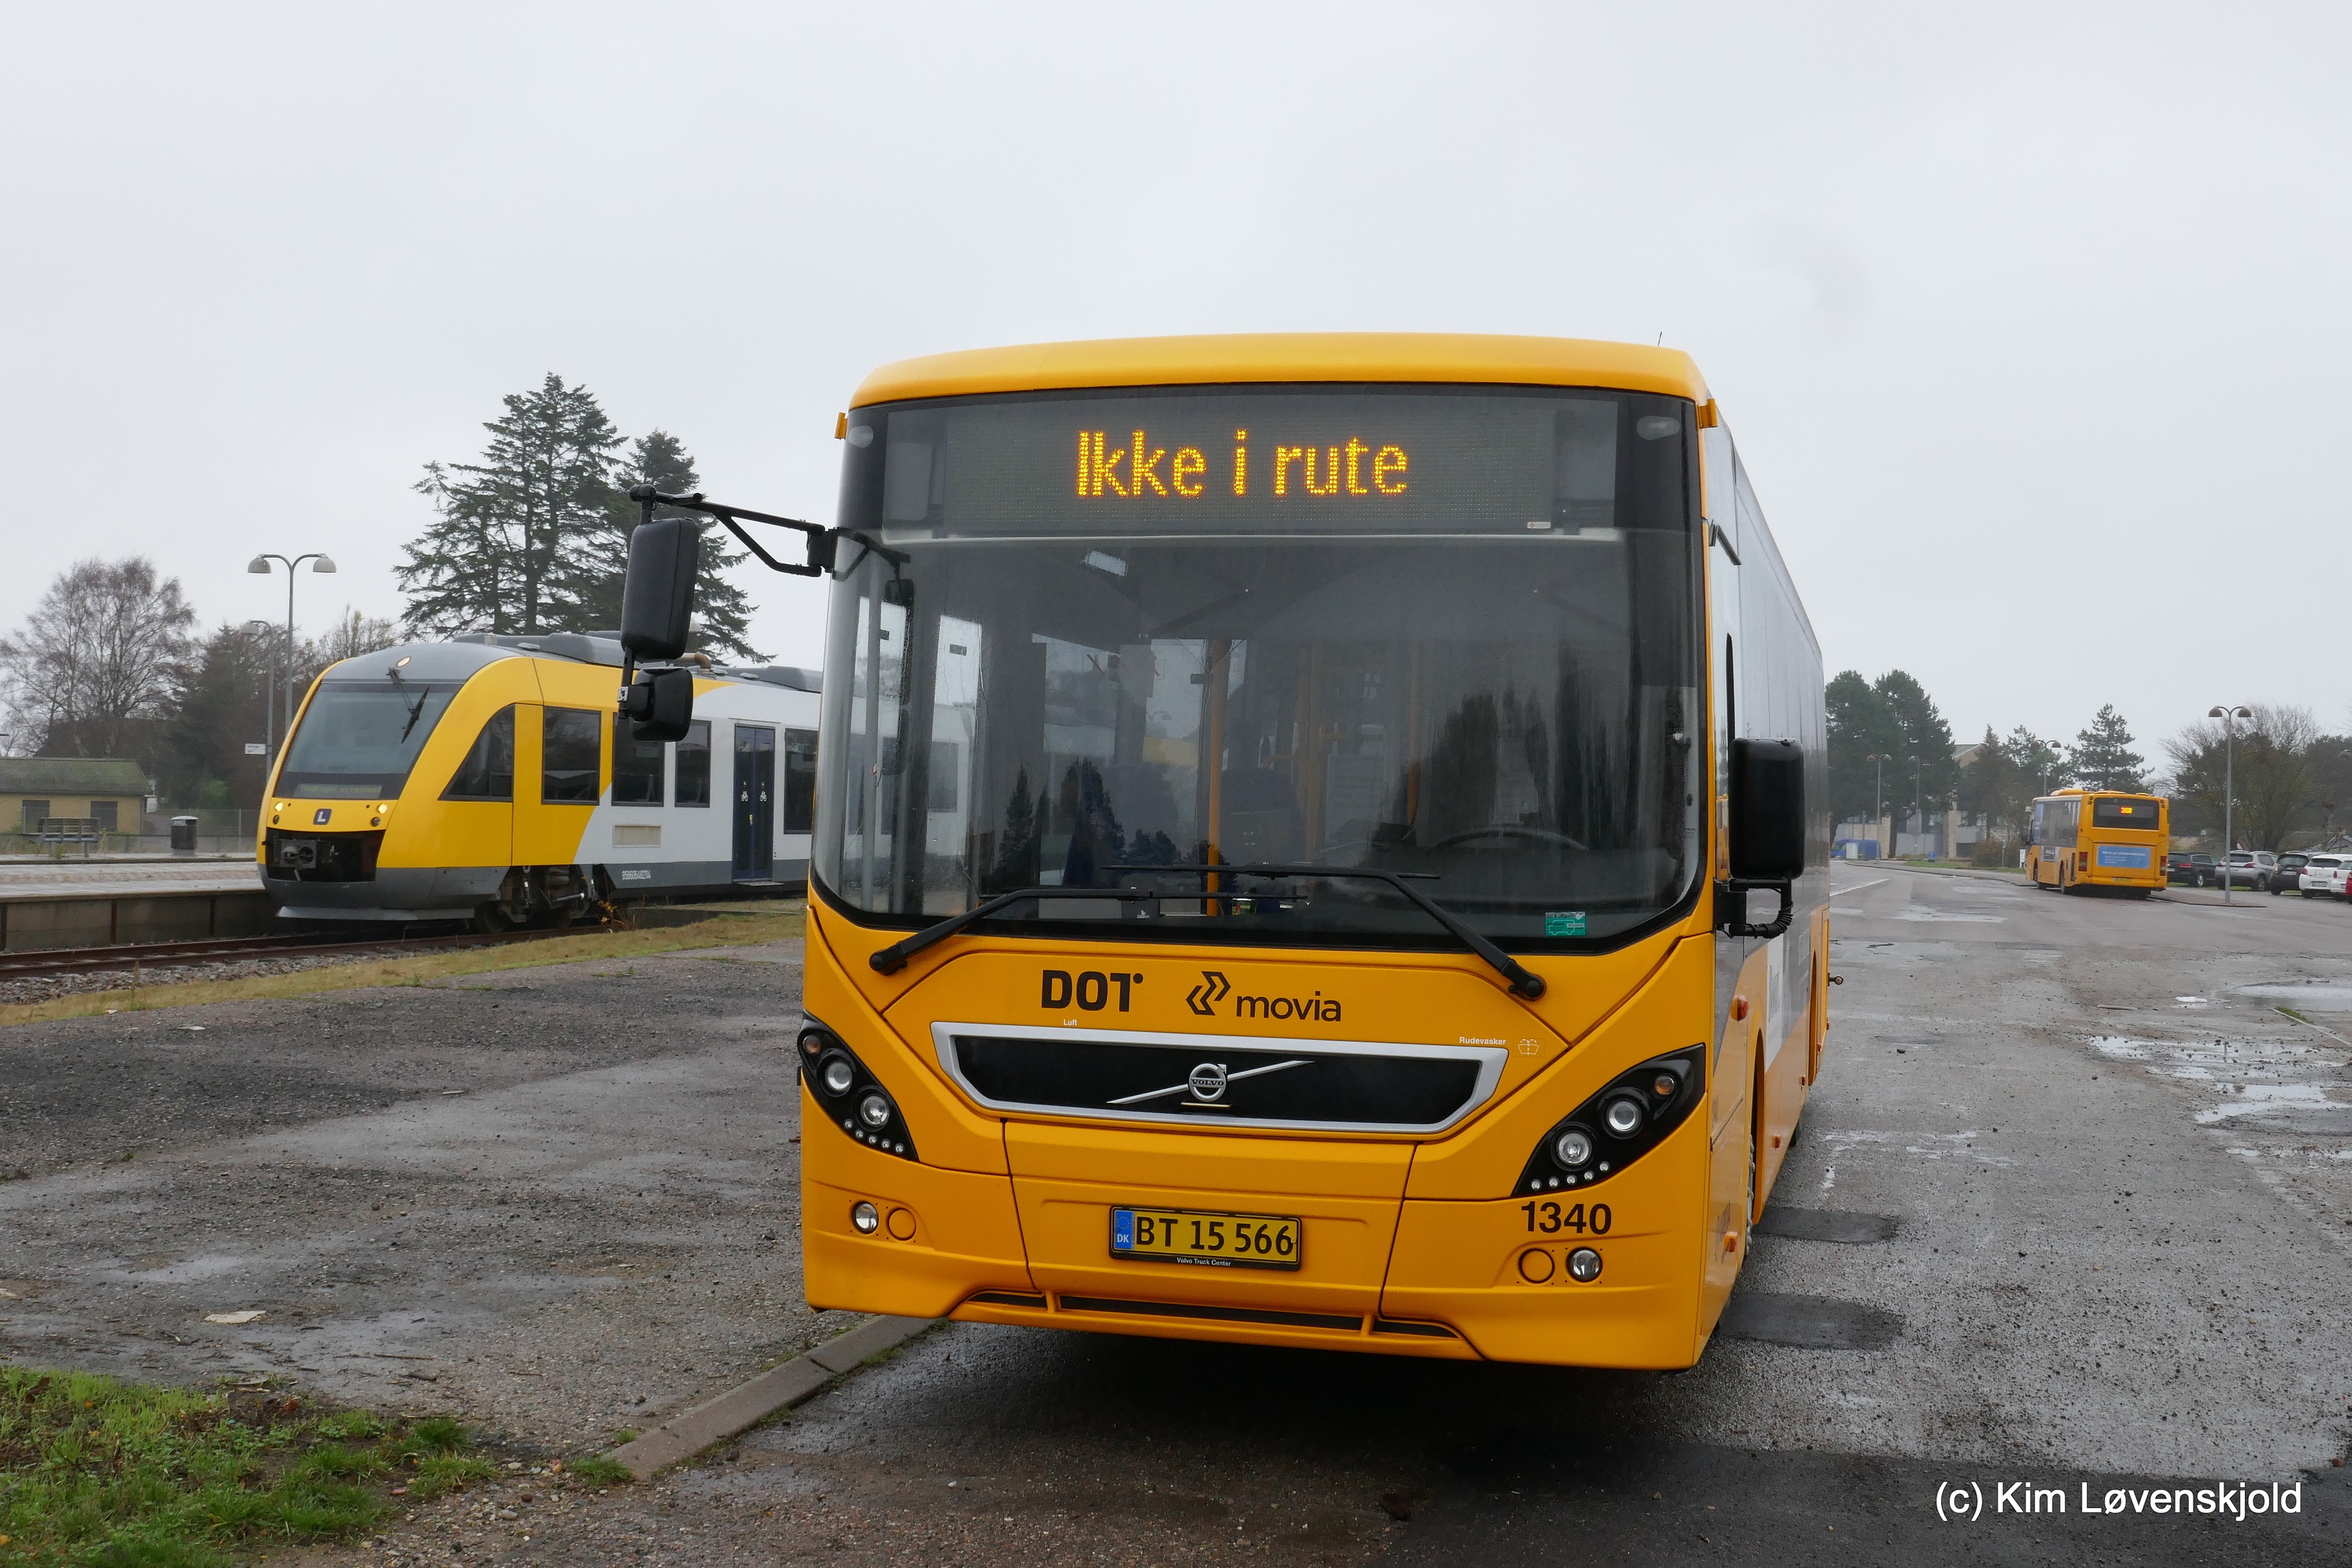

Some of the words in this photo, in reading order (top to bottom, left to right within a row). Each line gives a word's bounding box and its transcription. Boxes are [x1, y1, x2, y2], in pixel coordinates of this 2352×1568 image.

[1077, 429, 1206, 496] Ikke
[1234, 429, 1248, 496] i
[1275, 437, 1407, 496] rute
[317, 811, 326, 822] L
[1041, 970, 1144, 1012] DOT
[1236, 990, 1341, 1022] movia
[1459, 1036, 1507, 1045] Rudevasker
[1521, 1200, 1611, 1235] 1340
[1117, 1234, 1129, 1243] DK
[1136, 1216, 1178, 1248] BT
[1190, 1220, 1225, 1251] 15
[1234, 1223, 1294, 1256] 566
